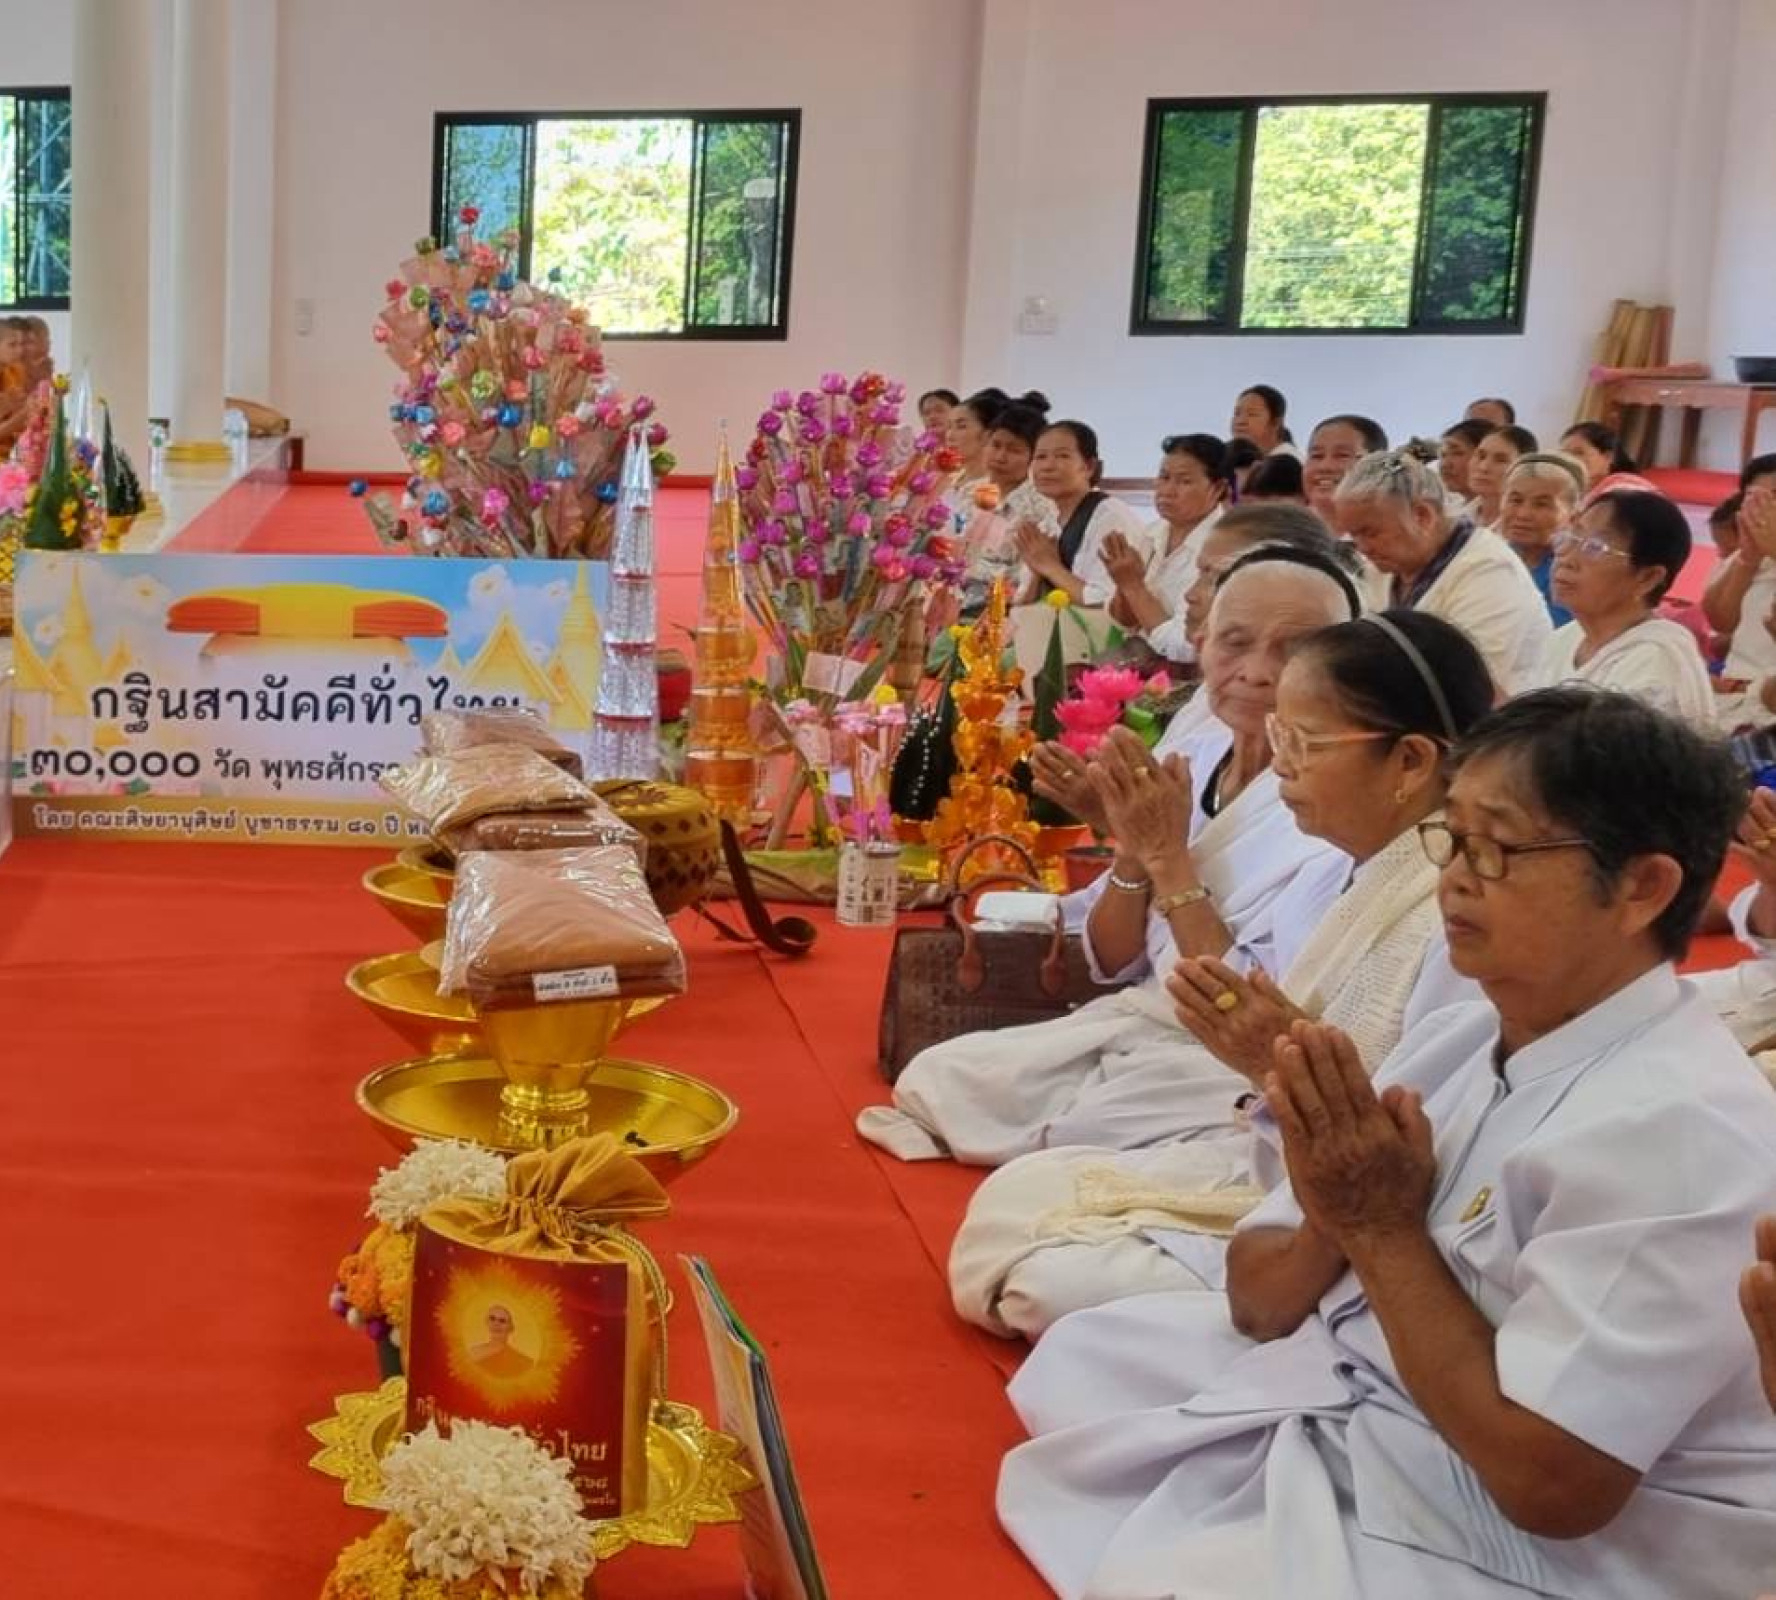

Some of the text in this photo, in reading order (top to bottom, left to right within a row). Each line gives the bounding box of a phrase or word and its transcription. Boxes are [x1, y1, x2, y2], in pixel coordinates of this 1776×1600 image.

[213, 749, 250, 778] วัด
[34, 804, 74, 829] โดย
[384, 813, 400, 835] ปี
